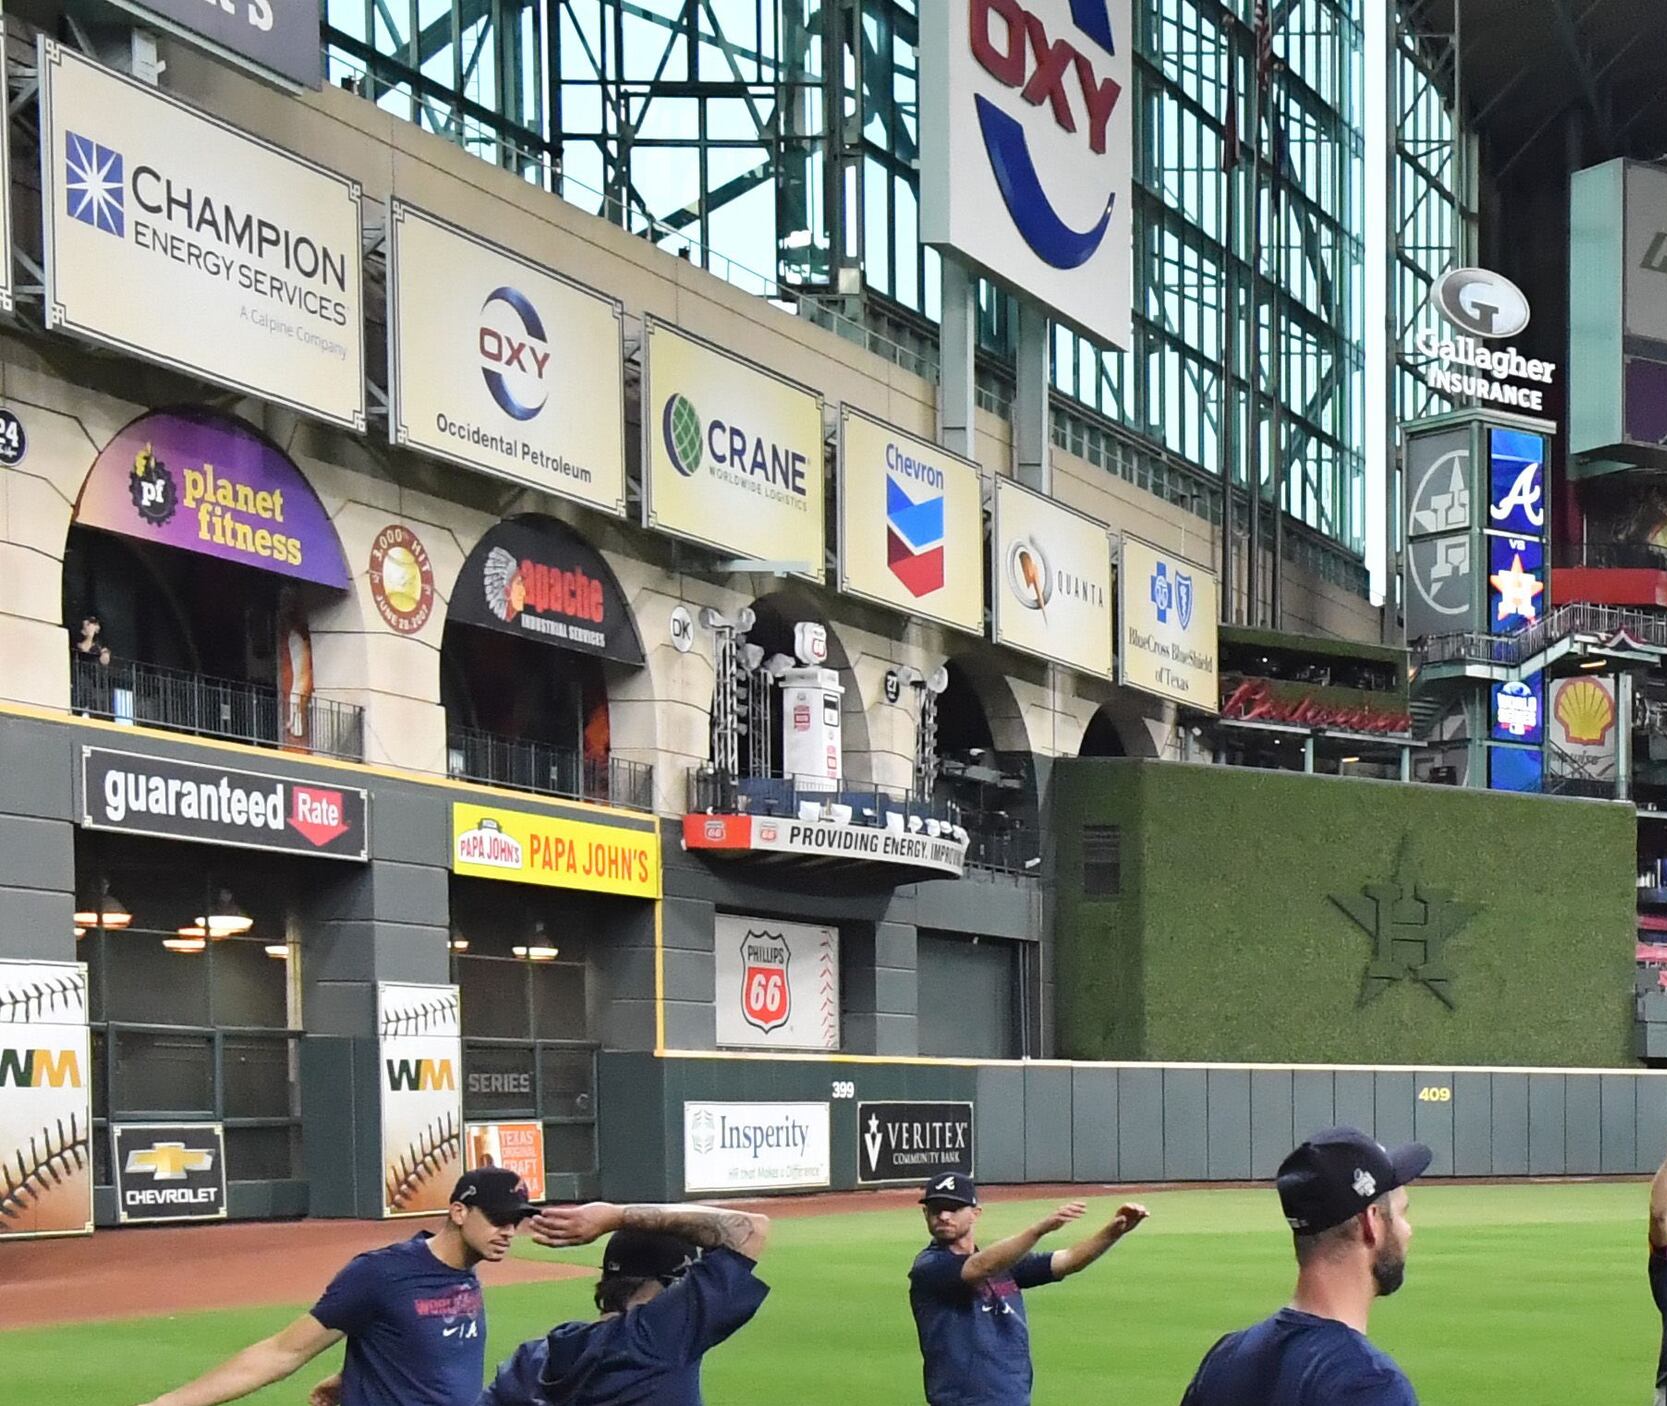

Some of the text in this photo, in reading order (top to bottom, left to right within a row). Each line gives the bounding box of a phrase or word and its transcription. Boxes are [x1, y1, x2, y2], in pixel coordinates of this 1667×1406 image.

[967, 0, 1122, 156] OXY
[131, 166, 347, 293] CHAMPION
[135, 220, 347, 327] ENERGY SERVICES
[240, 305, 348, 361] A Calpine Company
[478, 326, 552, 382] OXY
[1416, 329, 1556, 385] Gallagher
[1427, 365, 1543, 412] INSURANCE
[436, 413, 593, 484] Occidental Petroleum
[708, 419, 807, 497] CRANE
[886, 442, 945, 490] Chevron
[141, 478, 166, 507] pf
[183, 463, 284, 523] planet
[709, 465, 808, 513] WORLDWIDE LOGISTICS
[197, 501, 303, 567] fitness
[411, 540, 431, 572] HIT
[519, 559, 605, 624] apache
[1057, 569, 1104, 609] QUANTA
[520, 612, 606, 648] INDUSTRIAL SERVICES
[673, 618, 692, 641] DK
[1128, 626, 1213, 675] BlueCross BlueShield
[1165, 668, 1190, 692] Texas
[104, 768, 341, 831] guaranteed Rate
[460, 836, 521, 864] PAPA JOHN'S
[529, 833, 649, 884] PAPA JOHN'S
[789, 825, 879, 854] PROVIDING
[747, 943, 785, 965] PHILLIPS
[749, 973, 783, 1013] 66
[0, 1048, 82, 1089] WM
[386, 1057, 455, 1092] WM
[468, 1073, 531, 1093] SERIES
[831, 1081, 855, 1099] 399
[1418, 1087, 1452, 1102] 409
[502, 1129, 534, 1146] TEXAS
[720, 1114, 809, 1158] Insperity
[886, 1121, 966, 1150] VERITEX
[503, 1159, 538, 1176] CRAFT
[892, 1150, 961, 1166] COMMUNITY BANK
[125, 1186, 218, 1206] CHEVROLET
